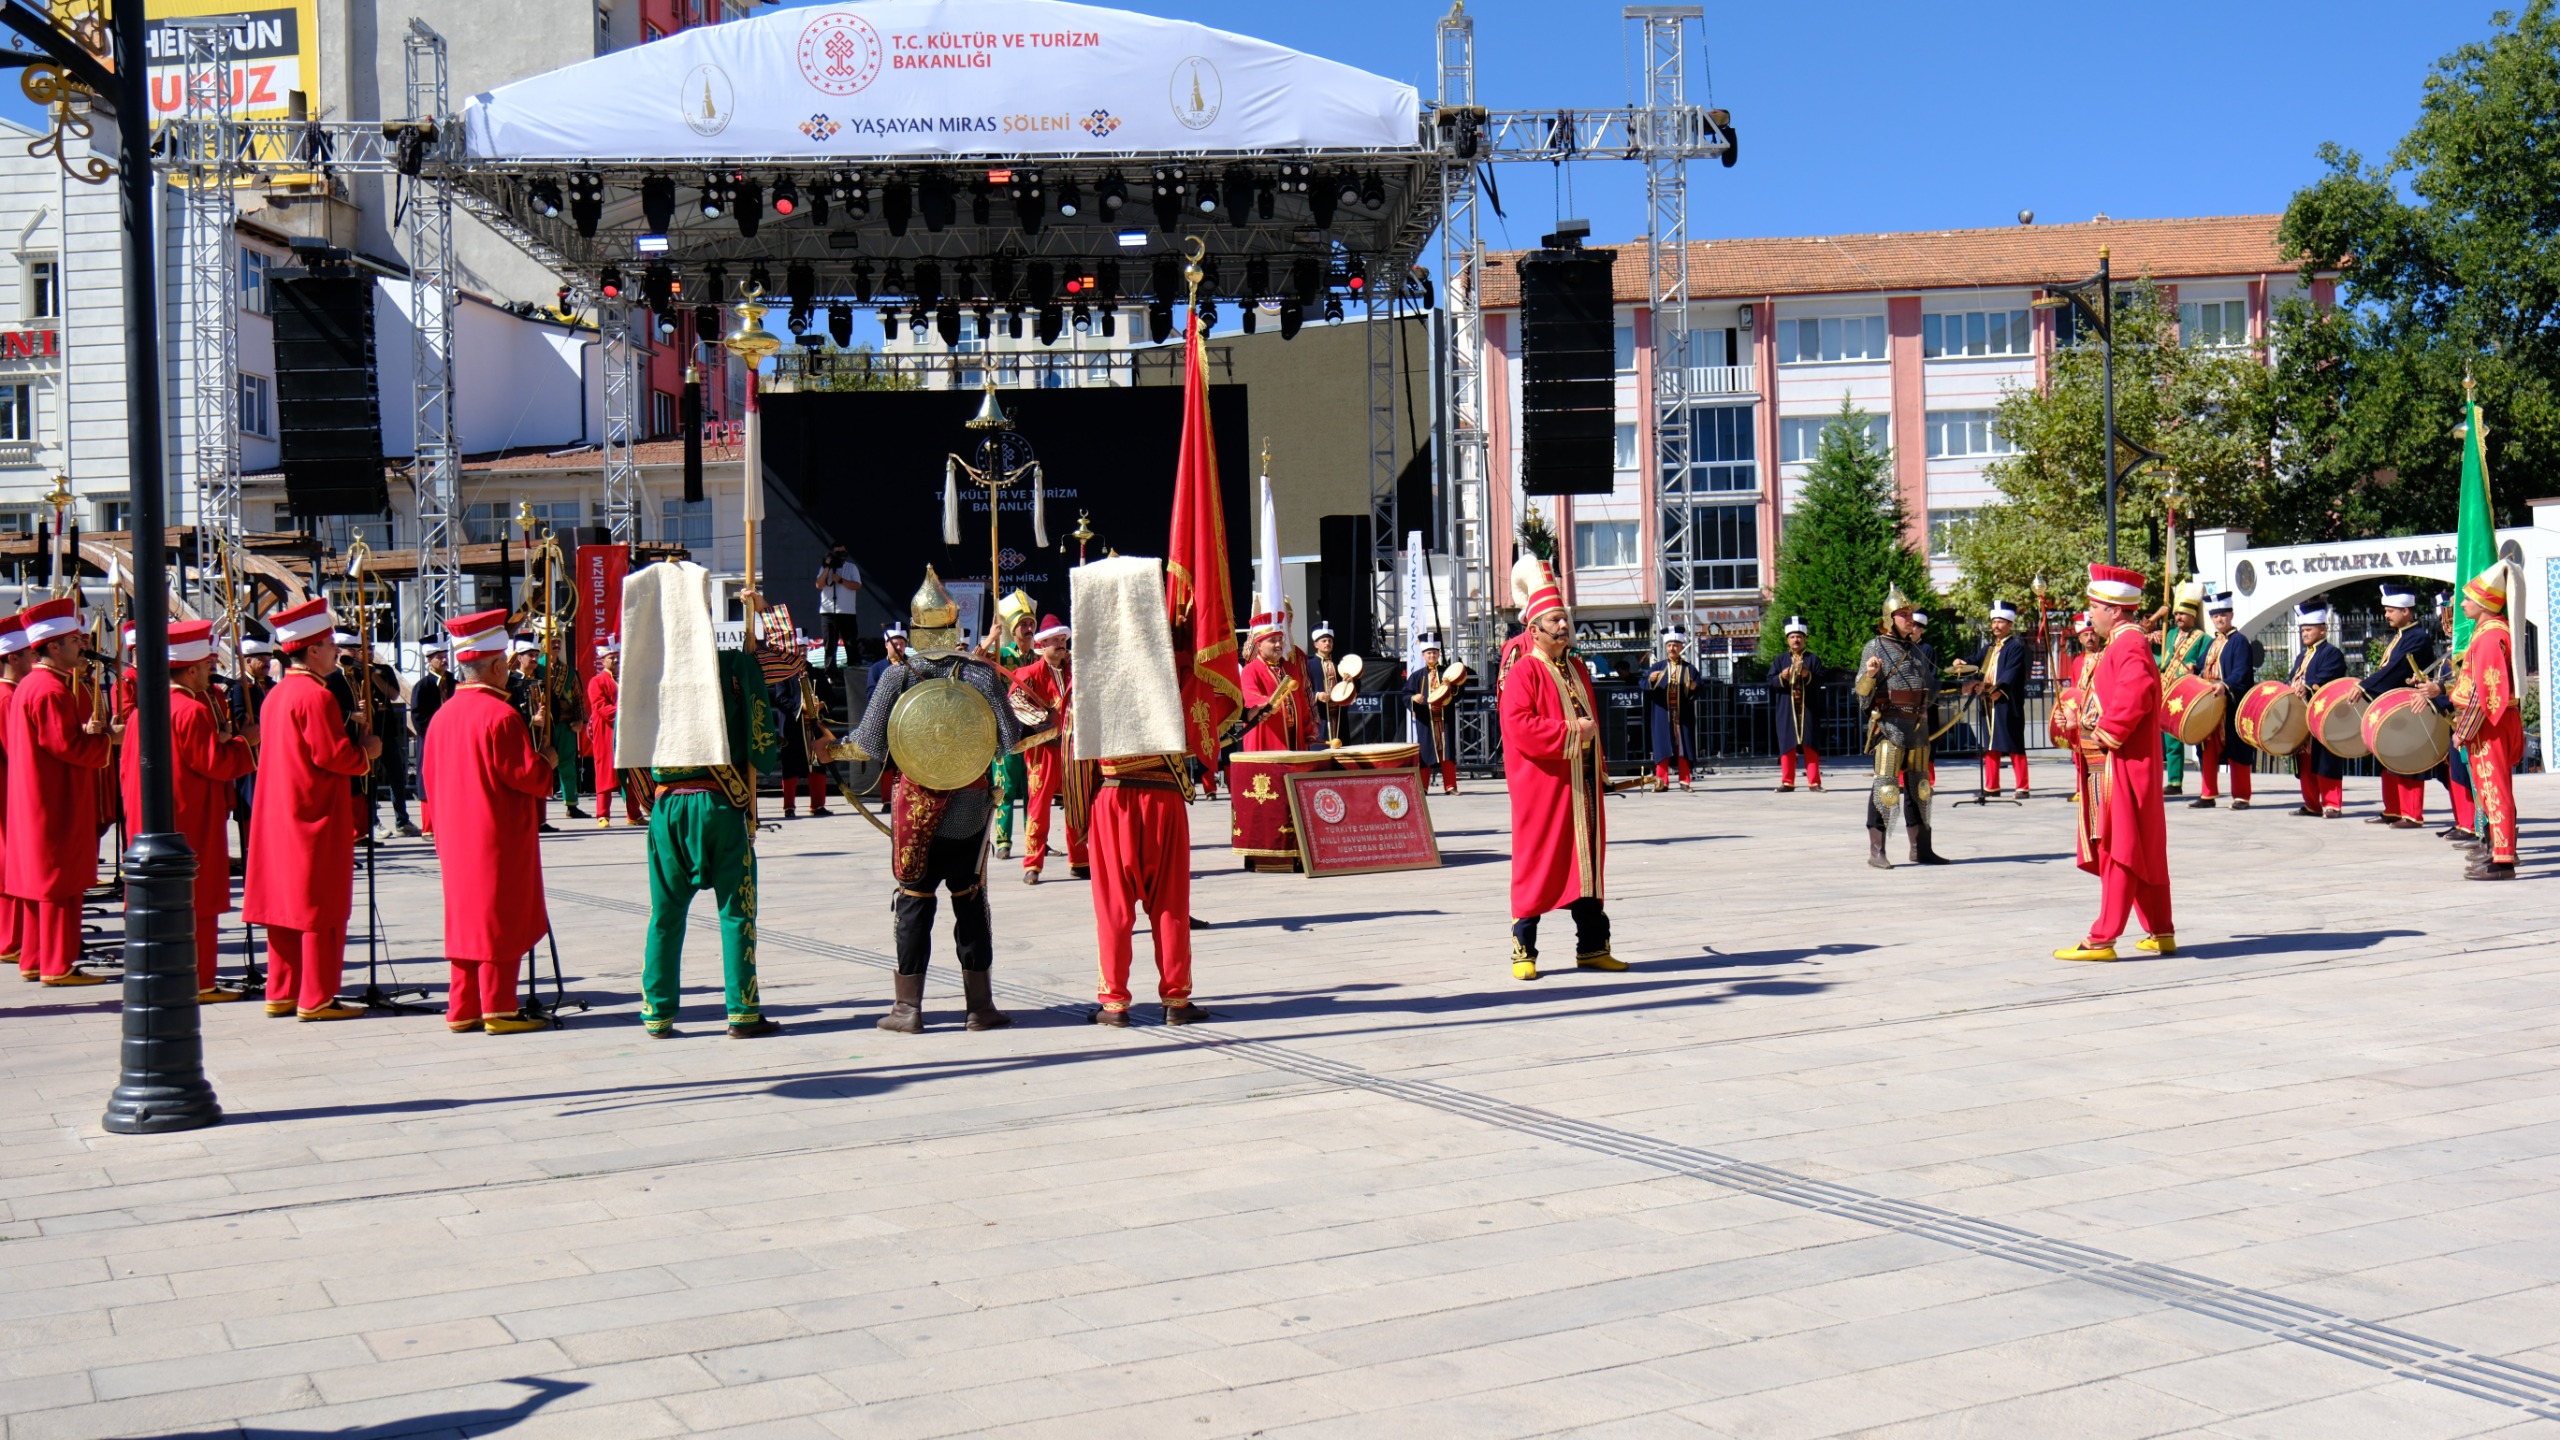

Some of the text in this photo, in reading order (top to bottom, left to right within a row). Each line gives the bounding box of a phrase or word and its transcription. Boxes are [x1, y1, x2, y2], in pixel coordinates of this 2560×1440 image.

[892, 30, 1100, 49] T.C. KÜLTÜR VE TURİZM
[893, 51, 992, 69] BAKANLIĞI
[151, 65, 277, 112] UCUZ
[851, 117, 934, 138] YAŞAYAN
[1003, 112, 1071, 134] ŞÖLENİ
[702, 420, 745, 447] TE
[1011, 489, 1026, 499] VE
[2265, 543, 2458, 576] T.C. KÜTAHYA VALİL
[592, 555, 605, 606] TURİZM
[1016, 572, 1048, 583] MİRAS
[595, 608, 605, 625] VE
[1576, 620, 1636, 639] ARLI
[1325, 821, 1409, 834] TÜRKİYE CUMHURİYETİ
[1342, 835, 1377, 844] SAVUNMA
[1378, 831, 1418, 841] BAKANLIĞI
